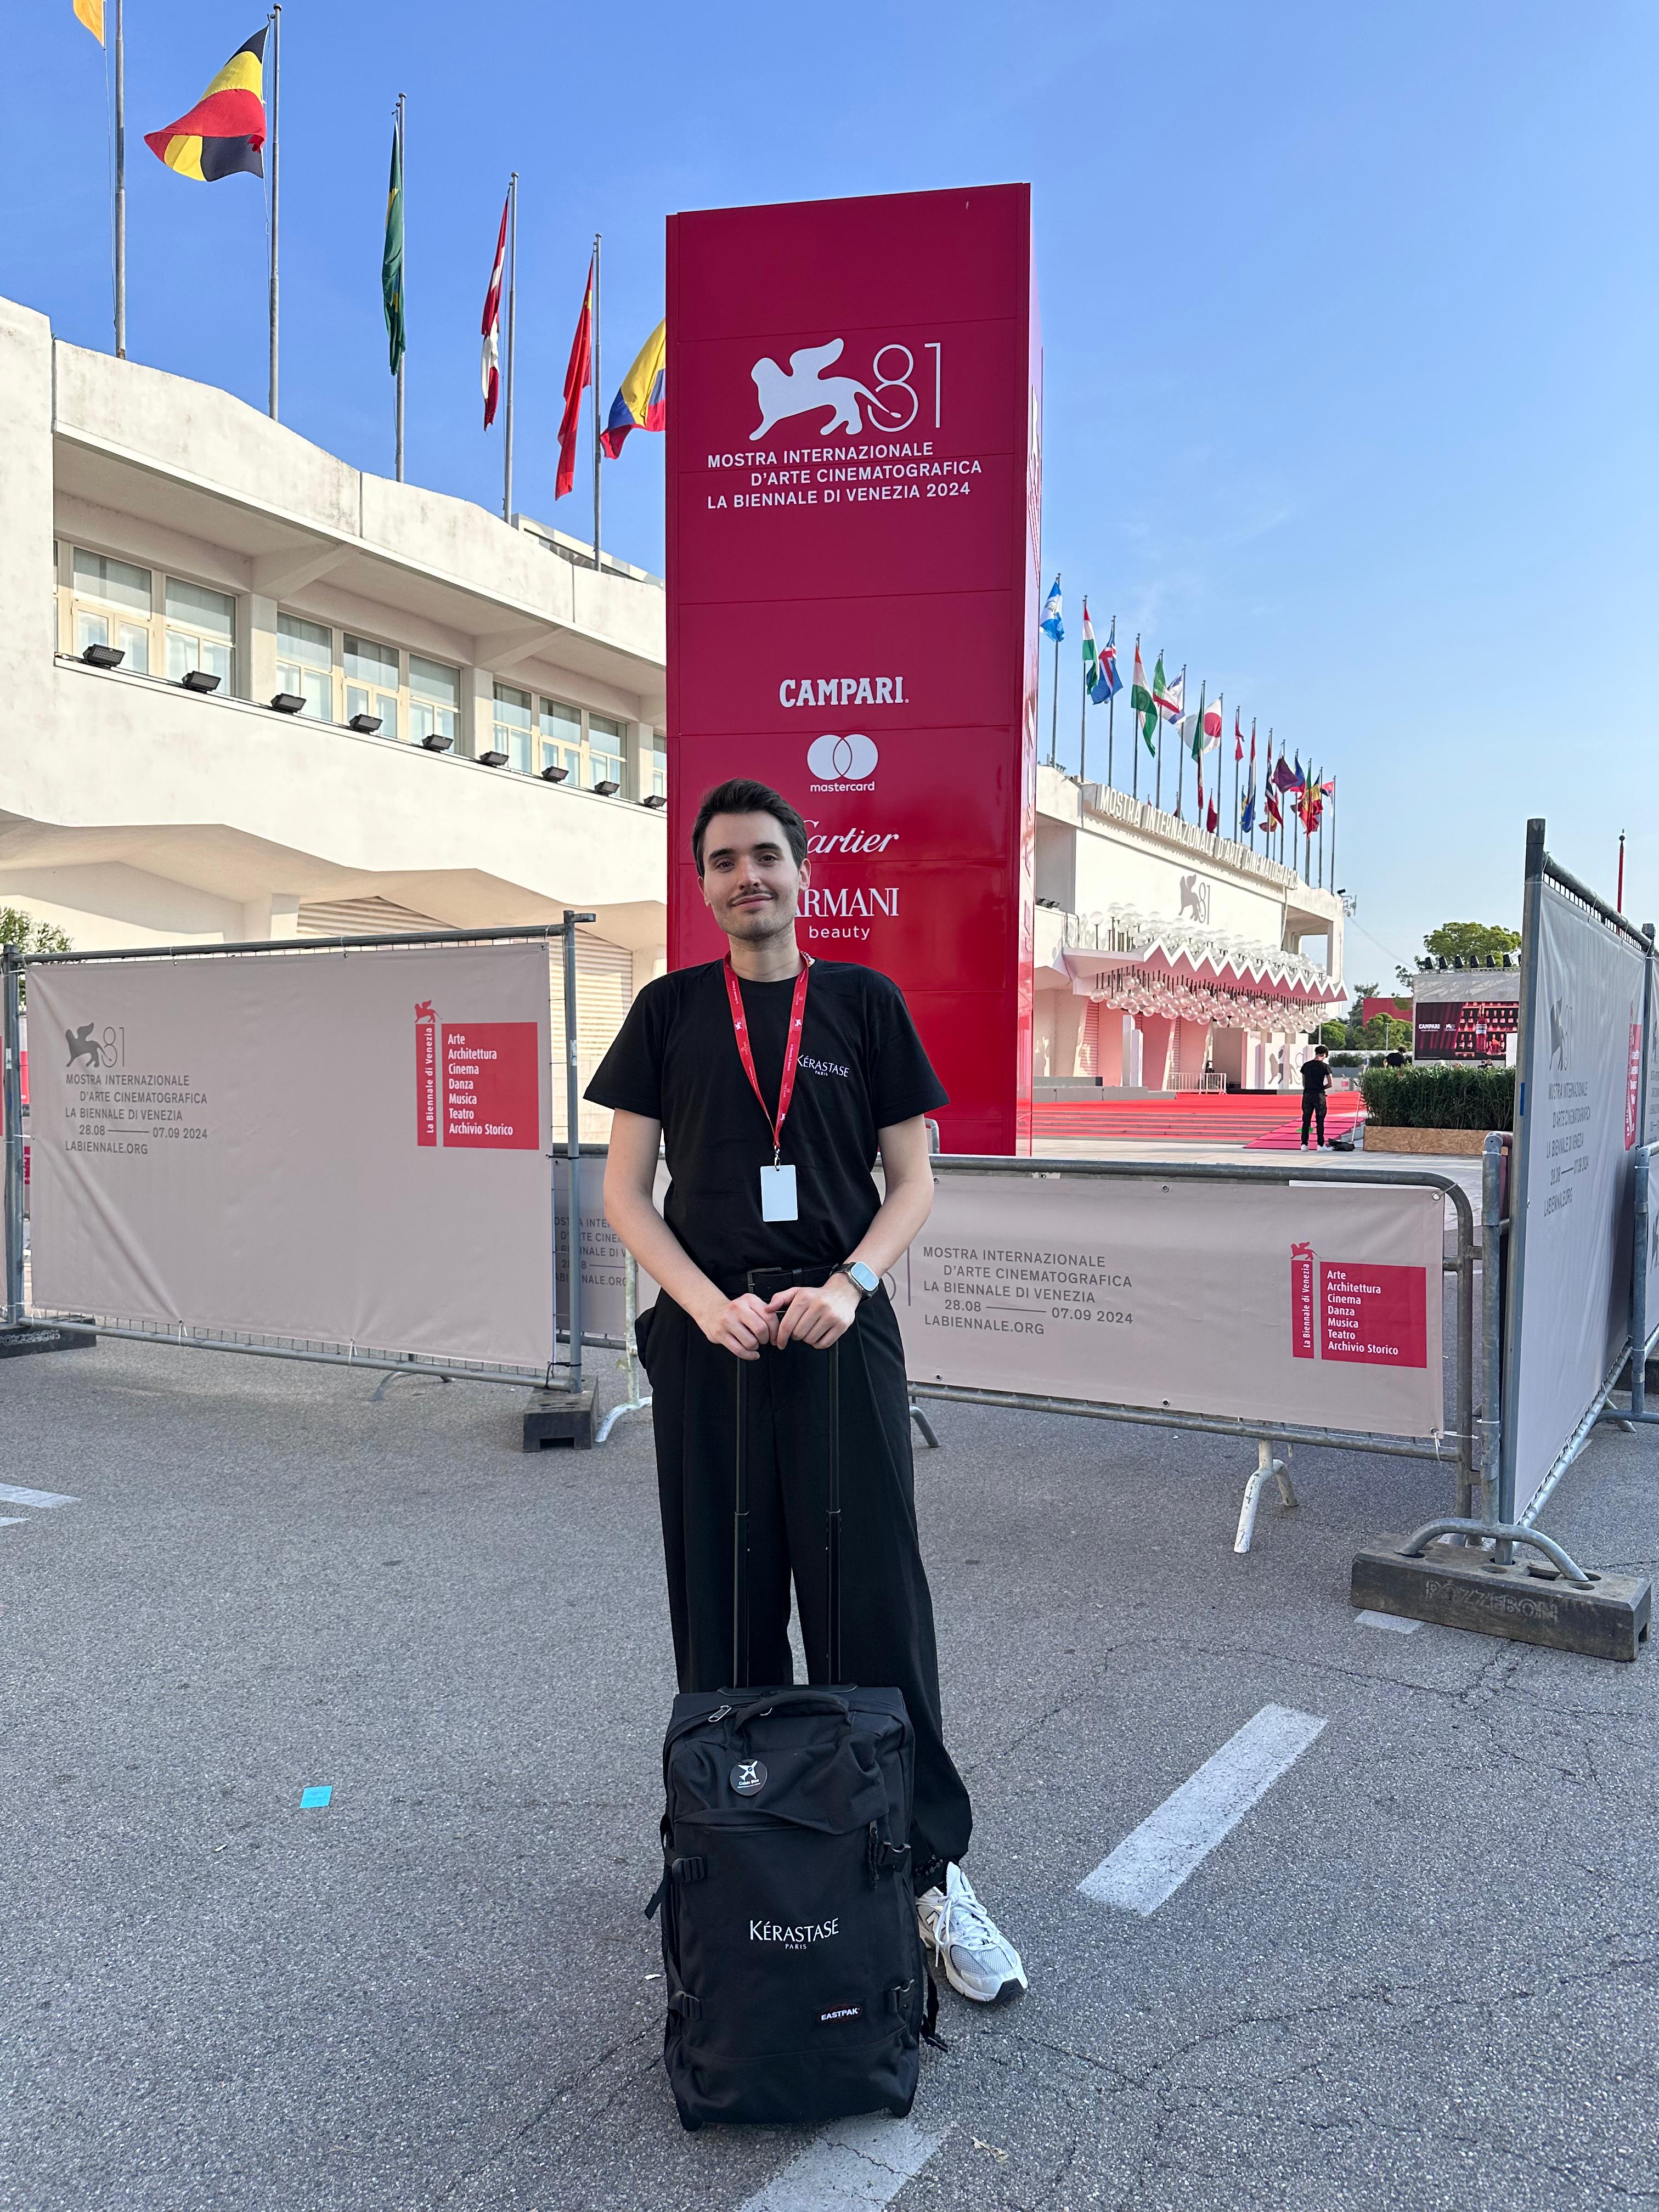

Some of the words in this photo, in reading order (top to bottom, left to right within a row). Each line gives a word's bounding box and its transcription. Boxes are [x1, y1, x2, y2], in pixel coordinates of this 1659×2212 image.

[867, 342, 941, 432] 81
[708, 451, 777, 469] MOSTRA
[783, 442, 934, 465] INTERNAZIONALE
[816, 460, 982, 483] CINEMATOGRAFICA
[708, 495, 727, 509] LA
[733, 490, 817, 508] BIENNALE
[824, 489, 840, 503] DI
[847, 485, 920, 502] VENEZIA
[926, 482, 970, 498] 2024
[779, 676, 905, 708] CAMPARI
[810, 781, 875, 793] mastercard
[1100, 784, 1142, 827] MOSTRA
[1146, 805, 1216, 856] INTERNAZIONALE
[1244, 849, 1300, 890] CINEMATOGRAFICA
[809, 925, 871, 940] beauty
[424, 1027, 433, 1064] Venezia
[448, 1033, 466, 1046] Arte
[448, 1048, 497, 1061] Architettura
[425, 1066, 433, 1076] di
[448, 1063, 479, 1076] Cinema
[65, 1074, 101, 1087] MOSTRA
[105, 1074, 190, 1086] INTERNAZIONALE
[448, 1078, 473, 1090] Danza
[80, 1091, 111, 1103] D'ARTE
[114, 1092, 208, 1104] CINEMATOGRAFICA
[425, 1079, 434, 1121] Biennale
[448, 1093, 477, 1106] Musica
[65, 1107, 77, 1119] LA
[80, 1107, 125, 1120] BIENNALE
[128, 1108, 138, 1120] DI
[142, 1109, 183, 1121] VENEZIA
[448, 1107, 475, 1120] Teatro
[79, 1124, 106, 1136] 28.08
[152, 1127, 180, 1139] 07.09
[183, 1127, 208, 1140] 2024
[426, 1122, 434, 1133] La
[449, 1122, 483, 1136] Archivio
[484, 1123, 514, 1136] Storico
[65, 1141, 148, 1155] LABIENNALE.ORG
[609, 1248, 618, 1257] DI
[923, 1246, 978, 1261] MOSTRA
[983, 1249, 1106, 1268] INTERNAZIONALE
[995, 1268, 1132, 1288] CINEMATOGRAFICA
[1301, 1263, 1310, 1293] Venezia
[1327, 1269, 1346, 1280] Arte
[923, 1280, 939, 1293] LA
[944, 1282, 1011, 1298] BIENNALE
[1015, 1286, 1029, 1299] DI
[1034, 1287, 1096, 1304] VENEZIA
[1327, 1282, 1381, 1295] Architettura
[1301, 1295, 1310, 1304] di
[1327, 1294, 1362, 1305] Cinema
[944, 1299, 981, 1313] 28.08
[1051, 1307, 1092, 1321] 07.09
[1097, 1311, 1133, 1324] 2024
[1327, 1305, 1355, 1317] Danza
[924, 1314, 1045, 1335] LABIENNALE.ORG
[1302, 1305, 1311, 1339] Biennale
[1328, 1317, 1359, 1329] Musica
[1328, 1329, 1356, 1340] Teatro
[1303, 1339, 1311, 1348] La
[1328, 1341, 1365, 1353] Archivio
[1367, 1344, 1399, 1356] Storico
[749, 1916, 839, 1944] KÉRASTASE
[821, 2007, 859, 2021] EASTPAK
